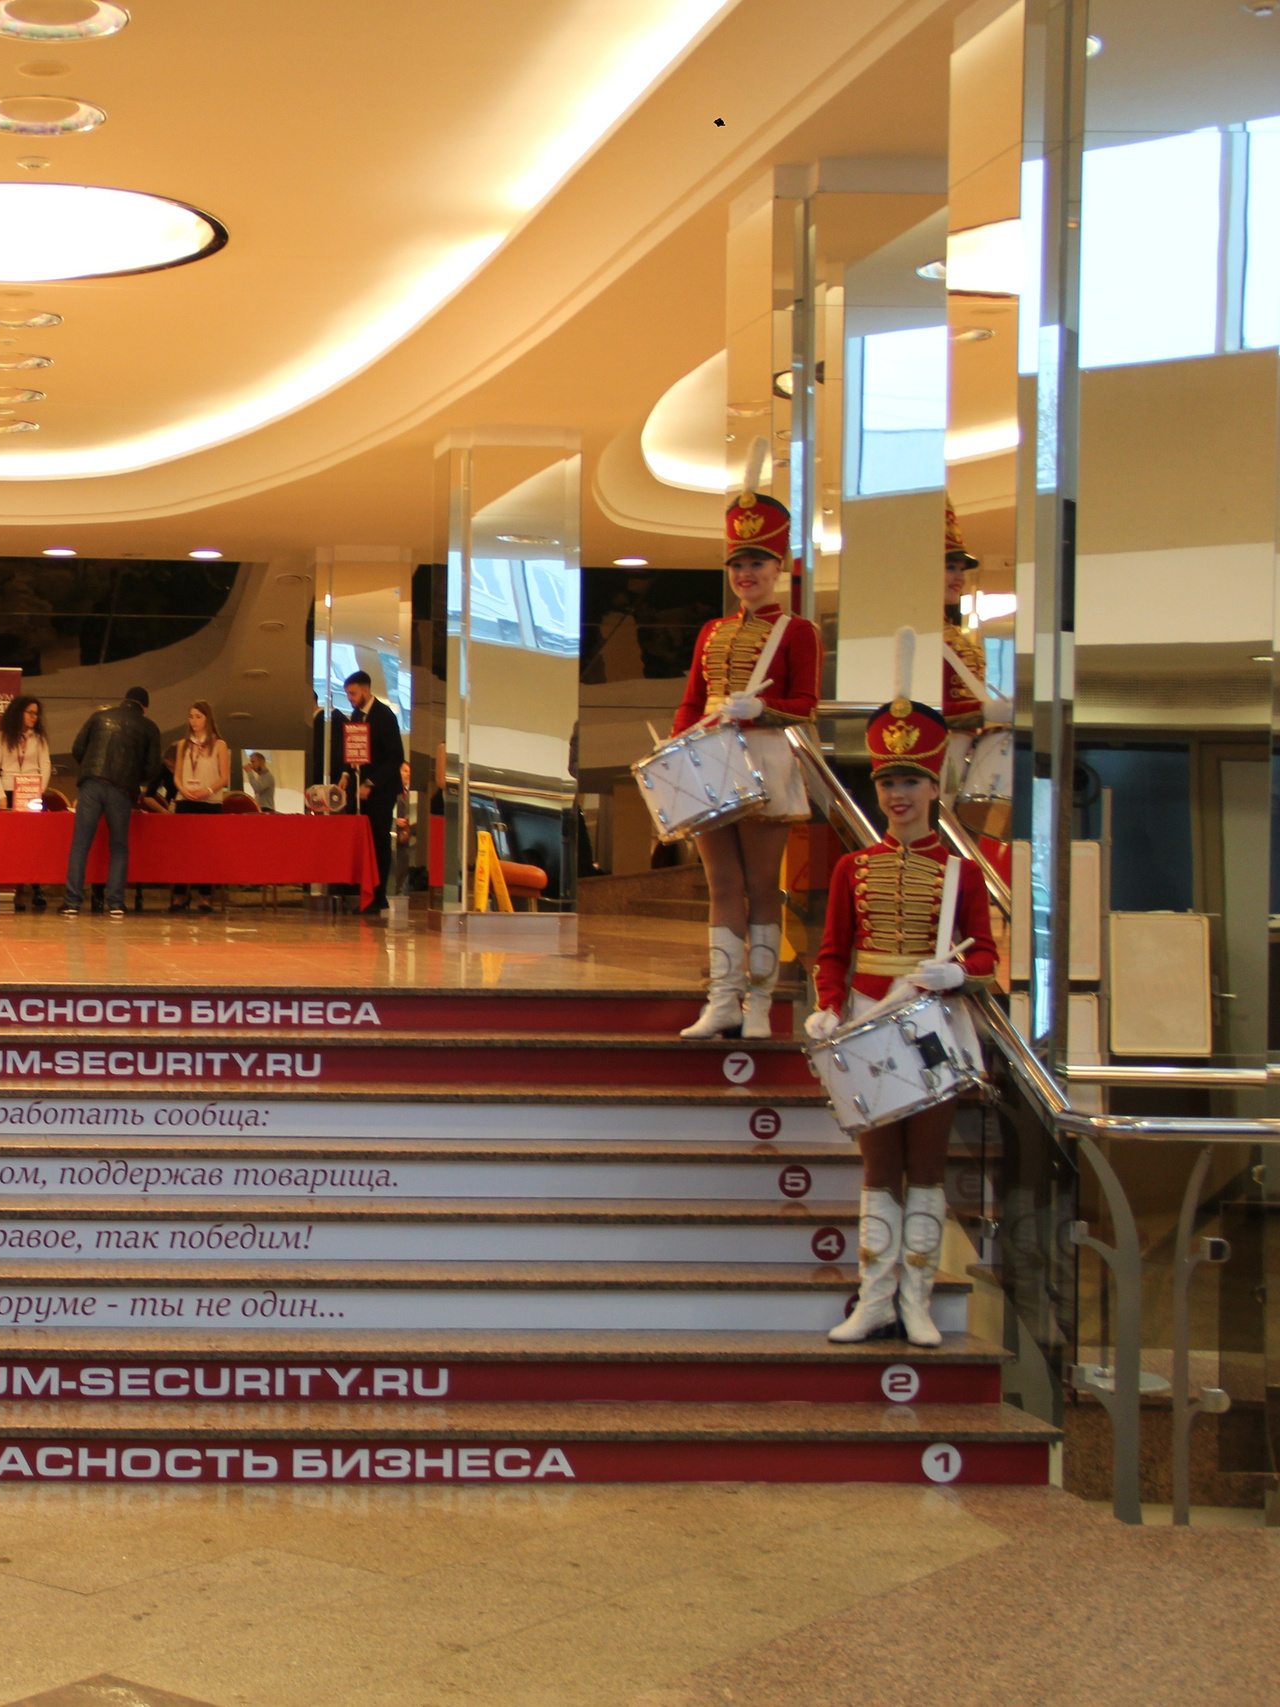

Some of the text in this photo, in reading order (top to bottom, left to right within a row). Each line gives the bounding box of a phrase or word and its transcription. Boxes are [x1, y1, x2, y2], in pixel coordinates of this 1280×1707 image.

[190, 1000, 381, 1026] БИЗНЕСА
[732, 1060, 747, 1075] 7
[153, 1104, 271, 1132] сообща:
[754, 1114, 776, 1133] 6
[58, 1160, 224, 1192] поддержав
[233, 1168, 399, 1193] товарища.
[784, 1172, 806, 1191] 5
[95, 1230, 160, 1249] так
[169, 1224, 313, 1251] победим!
[816, 1234, 840, 1254] 4
[130, 1297, 184, 1317] ты
[195, 1297, 232, 1317] не
[241, 1291, 346, 1319] один...
[888, 1373, 911, 1393] 2
[292, 1448, 576, 1479] БИЗНЕСА
[933, 1452, 950, 1473] 1
